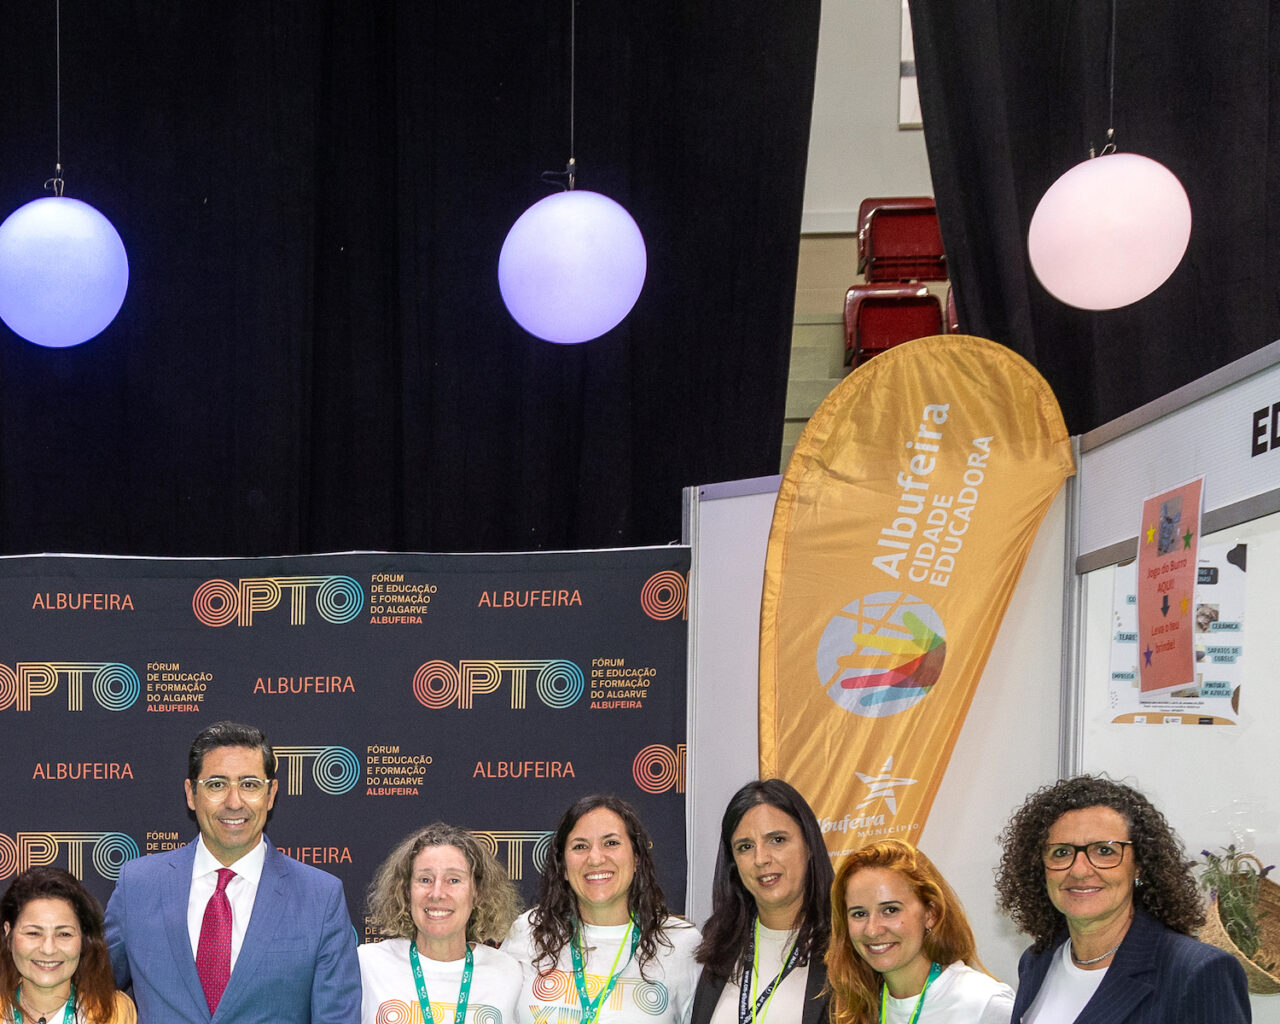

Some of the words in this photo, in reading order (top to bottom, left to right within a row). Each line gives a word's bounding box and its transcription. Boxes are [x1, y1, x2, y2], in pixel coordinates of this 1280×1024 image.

[872, 403, 950, 579] Albufeira
[929, 436, 994, 587] EDUCADORA
[908, 494, 953, 582] CIDADE
[371, 573, 404, 583] FÓRUM
[371, 584, 384, 593] DE
[386, 583, 437, 595] EDUCAÇÃO
[32, 593, 135, 611] ALBUFEIRA
[192, 575, 365, 627] OPTO
[370, 595, 377, 604] E
[379, 594, 431, 605] FORMAÇÃO
[478, 589, 583, 608] ALBUFEIRA
[370, 606, 384, 614] DO
[386, 605, 428, 614] ALGARVE
[370, 616, 423, 625] ALBUFEIRA
[147, 660, 180, 671] FÓRUM
[592, 657, 624, 667] FÓRUM
[147, 673, 160, 682] DE
[161, 671, 213, 683] EDUCAÇÃO
[592, 669, 604, 678] DE
[606, 667, 657, 679] EDUCAÇÃO
[147, 683, 154, 692] E
[155, 682, 207, 693] FORMAÇÃO
[253, 676, 356, 694] ALBUFEIRA
[413, 659, 585, 709] OPTO
[591, 680, 597, 688] E
[599, 678, 650, 690] FORMAÇÃO
[147, 694, 161, 702] DO
[163, 694, 204, 702] ALGARVE
[591, 690, 605, 699] DO
[606, 690, 647, 699] ALGARVE
[147, 704, 200, 712] ALBUFEIRA
[590, 700, 643, 709] ALBUFEIRA
[367, 743, 400, 754] FÓRUM
[367, 756, 380, 765] DE
[382, 754, 433, 766] EDUCAÇÃO
[32, 762, 134, 780] ALBUFEIRA
[367, 766, 373, 775] E
[375, 765, 427, 776] FORMAÇÃO
[473, 761, 576, 778] ALBUFEIRA
[367, 777, 380, 786] DO
[382, 777, 423, 786] ALGARVE
[366, 787, 419, 796] ALBUFEIRA
[146, 830, 179, 840] FÓRUM
[146, 842, 159, 851] DE
